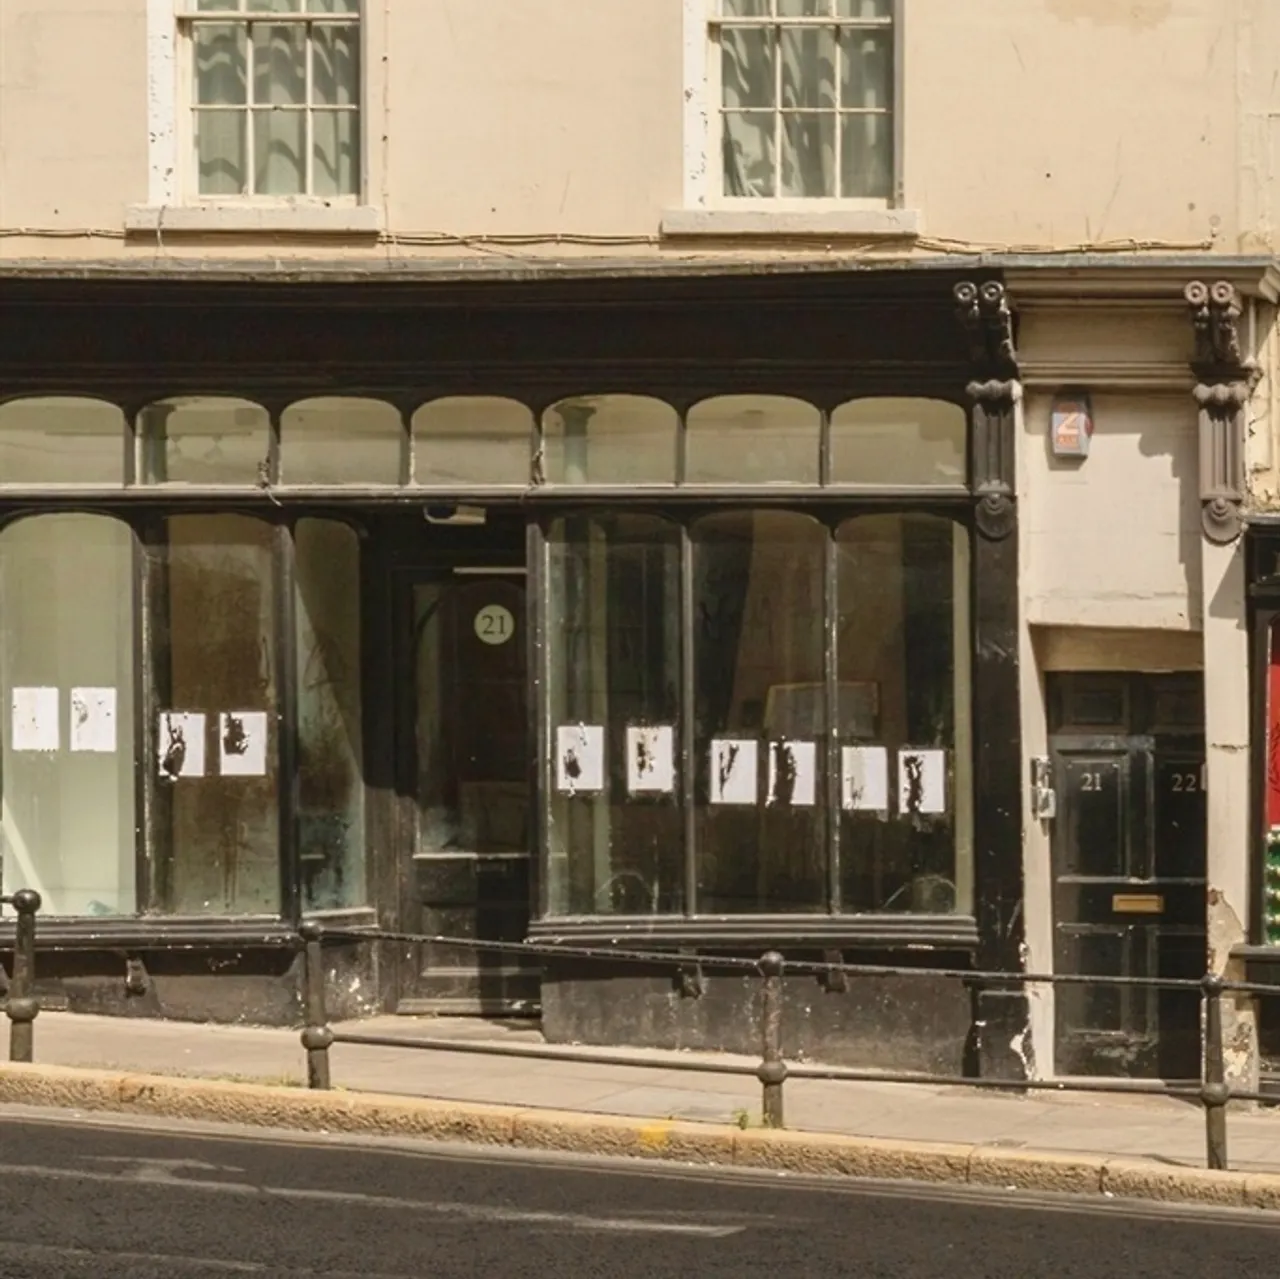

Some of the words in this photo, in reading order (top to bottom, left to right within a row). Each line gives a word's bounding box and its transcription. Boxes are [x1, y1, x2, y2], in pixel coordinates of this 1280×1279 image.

[481, 614, 507, 635] 21
[1081, 772, 1102, 791] 21
[1171, 773, 1197, 792] 22
